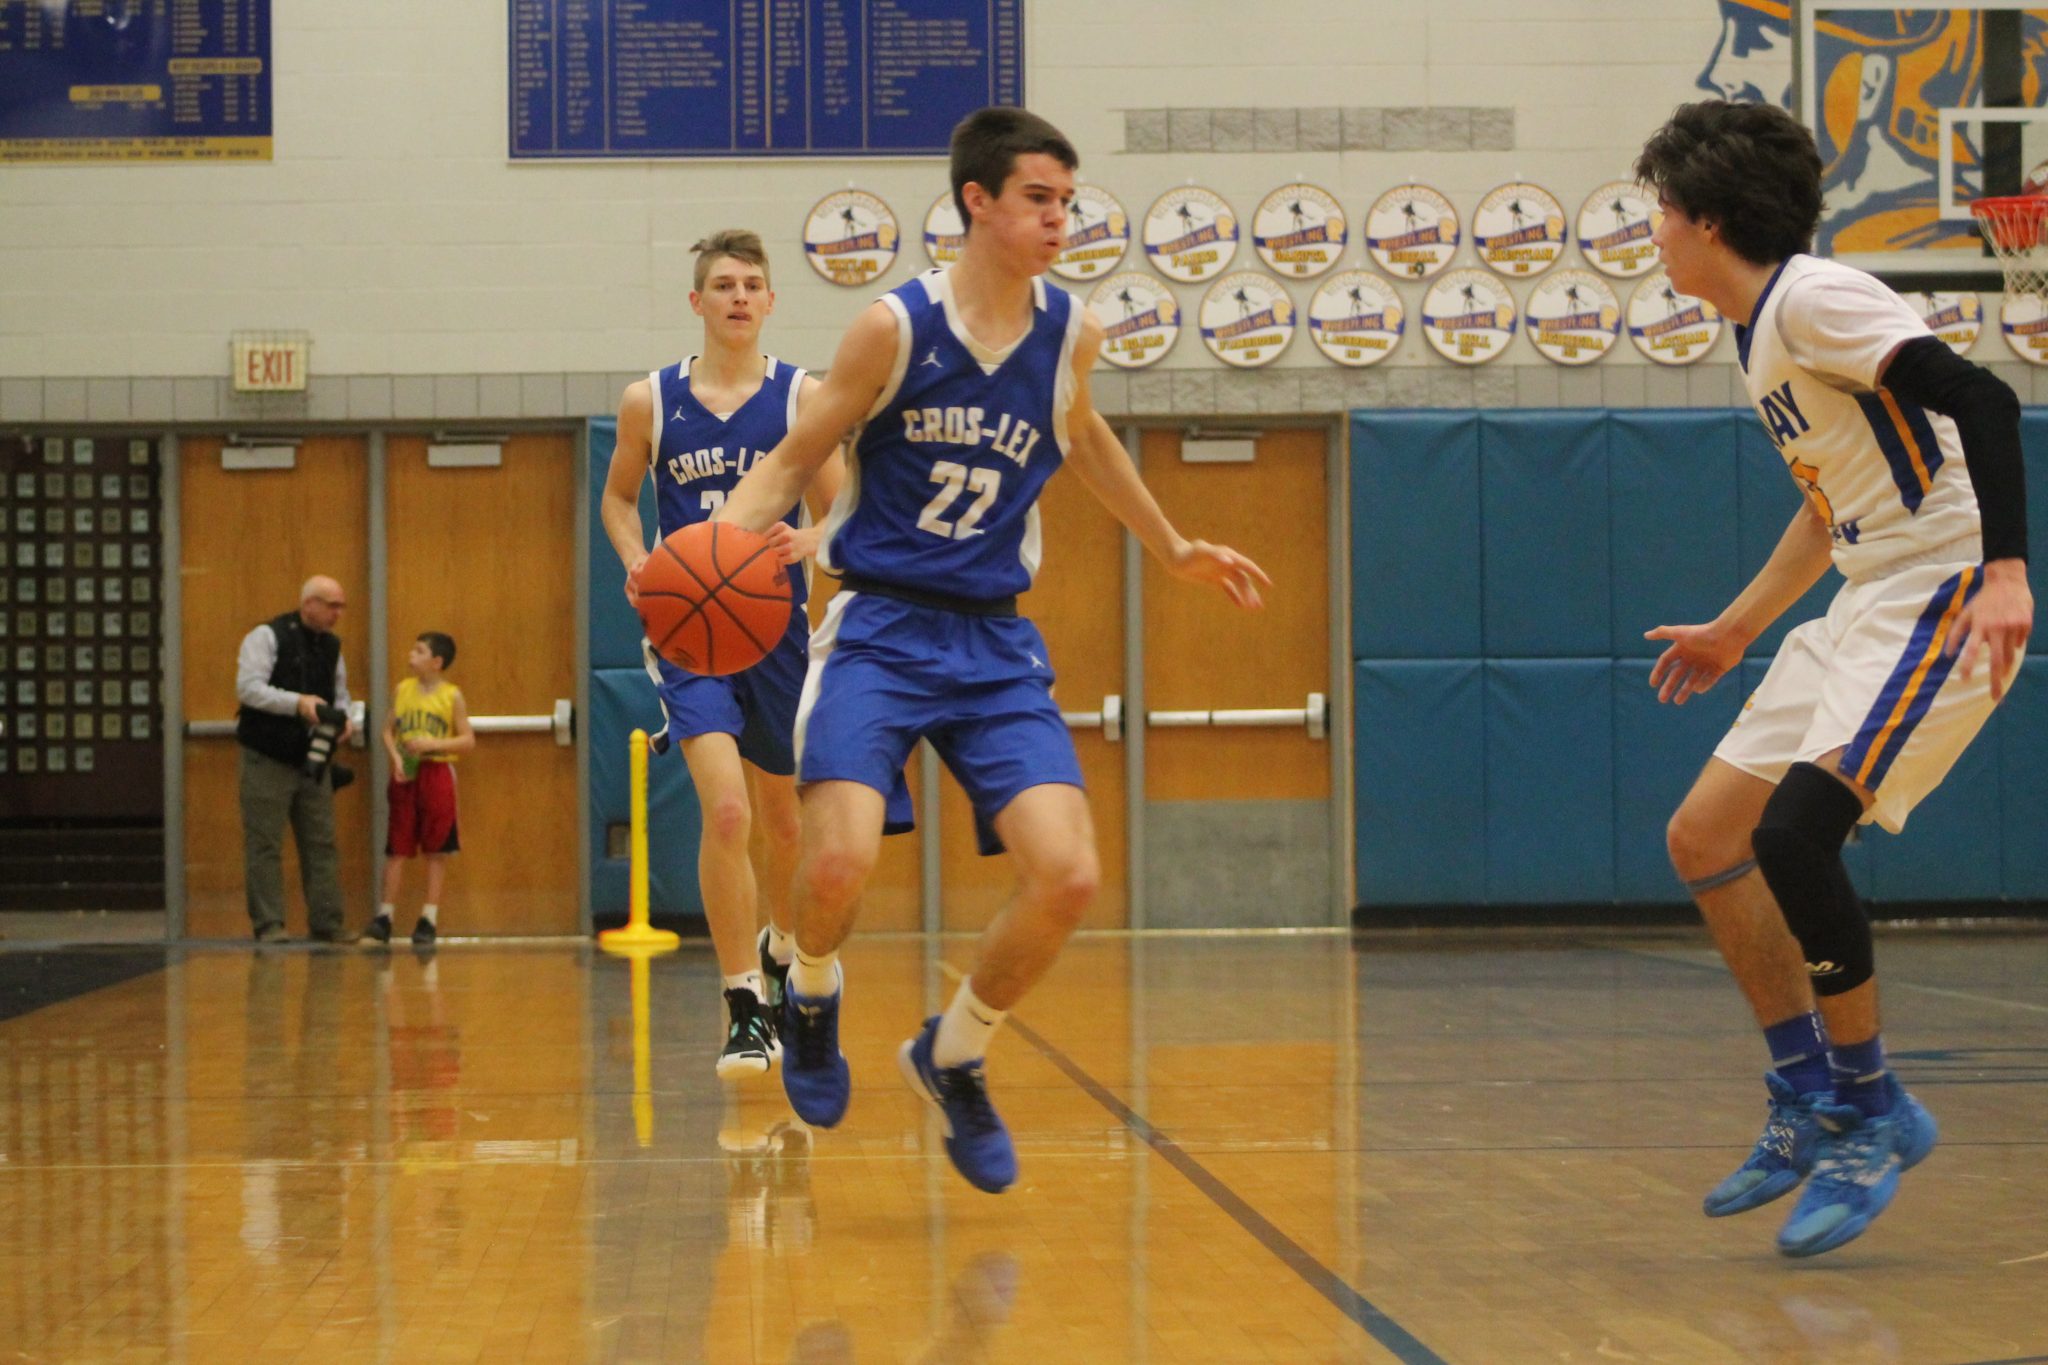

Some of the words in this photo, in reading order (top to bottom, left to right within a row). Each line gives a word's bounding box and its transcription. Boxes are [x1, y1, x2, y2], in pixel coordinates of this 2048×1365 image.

[248, 350, 295, 384] EXIT
[902, 406, 1041, 468] CROS-LEX
[916, 461, 1002, 541] 22
